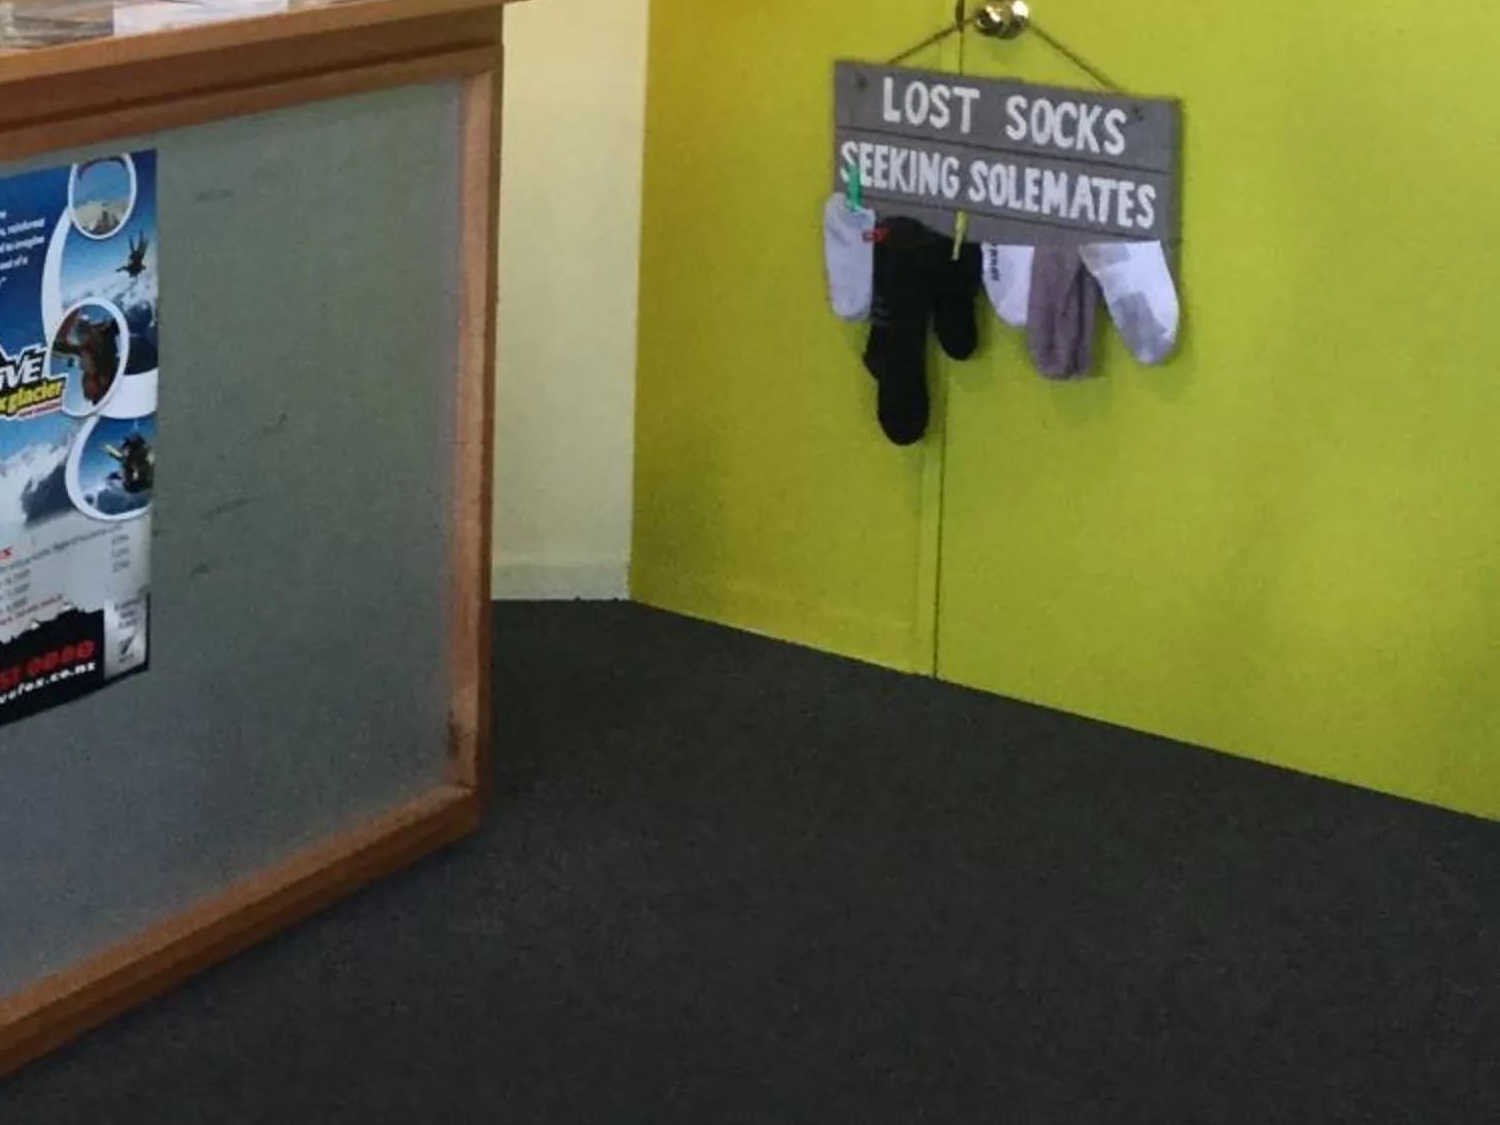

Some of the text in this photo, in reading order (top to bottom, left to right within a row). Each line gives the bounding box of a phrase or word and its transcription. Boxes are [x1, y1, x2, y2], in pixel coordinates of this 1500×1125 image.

[883, 76, 1128, 156] LOST SOCKS
[839, 140, 1157, 230] SEEKING SOLEMATES
